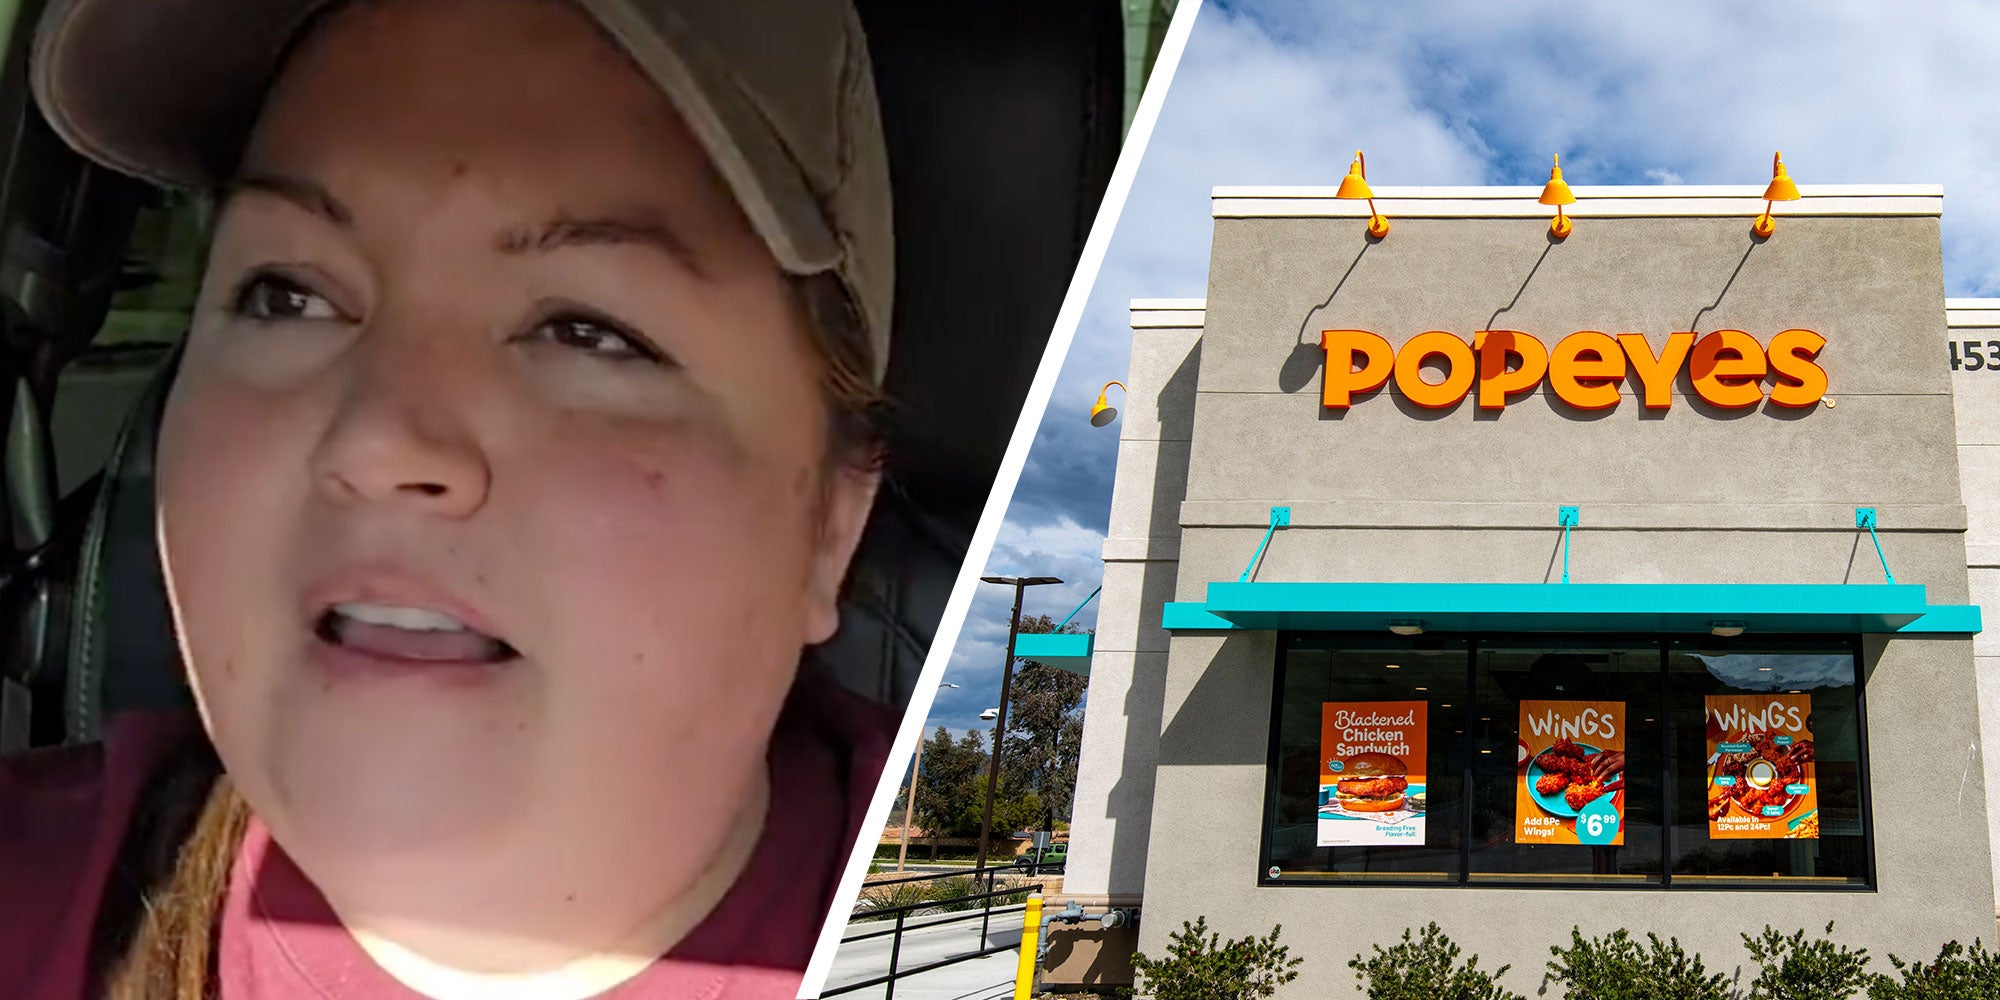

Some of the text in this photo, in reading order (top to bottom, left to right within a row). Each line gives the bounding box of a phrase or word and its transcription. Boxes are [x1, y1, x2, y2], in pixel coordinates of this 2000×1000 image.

[1334, 709, 1415, 730] Blackened
[1342, 728, 1404, 742] Chicken
[1336, 742, 1409, 757] Sandwich
[1524, 817, 1560, 826] Add 6Pc
[1751, 815, 1759, 823] in
[1524, 827, 1555, 837] Wings!
[1750, 823, 1771, 831] 24Pc!
